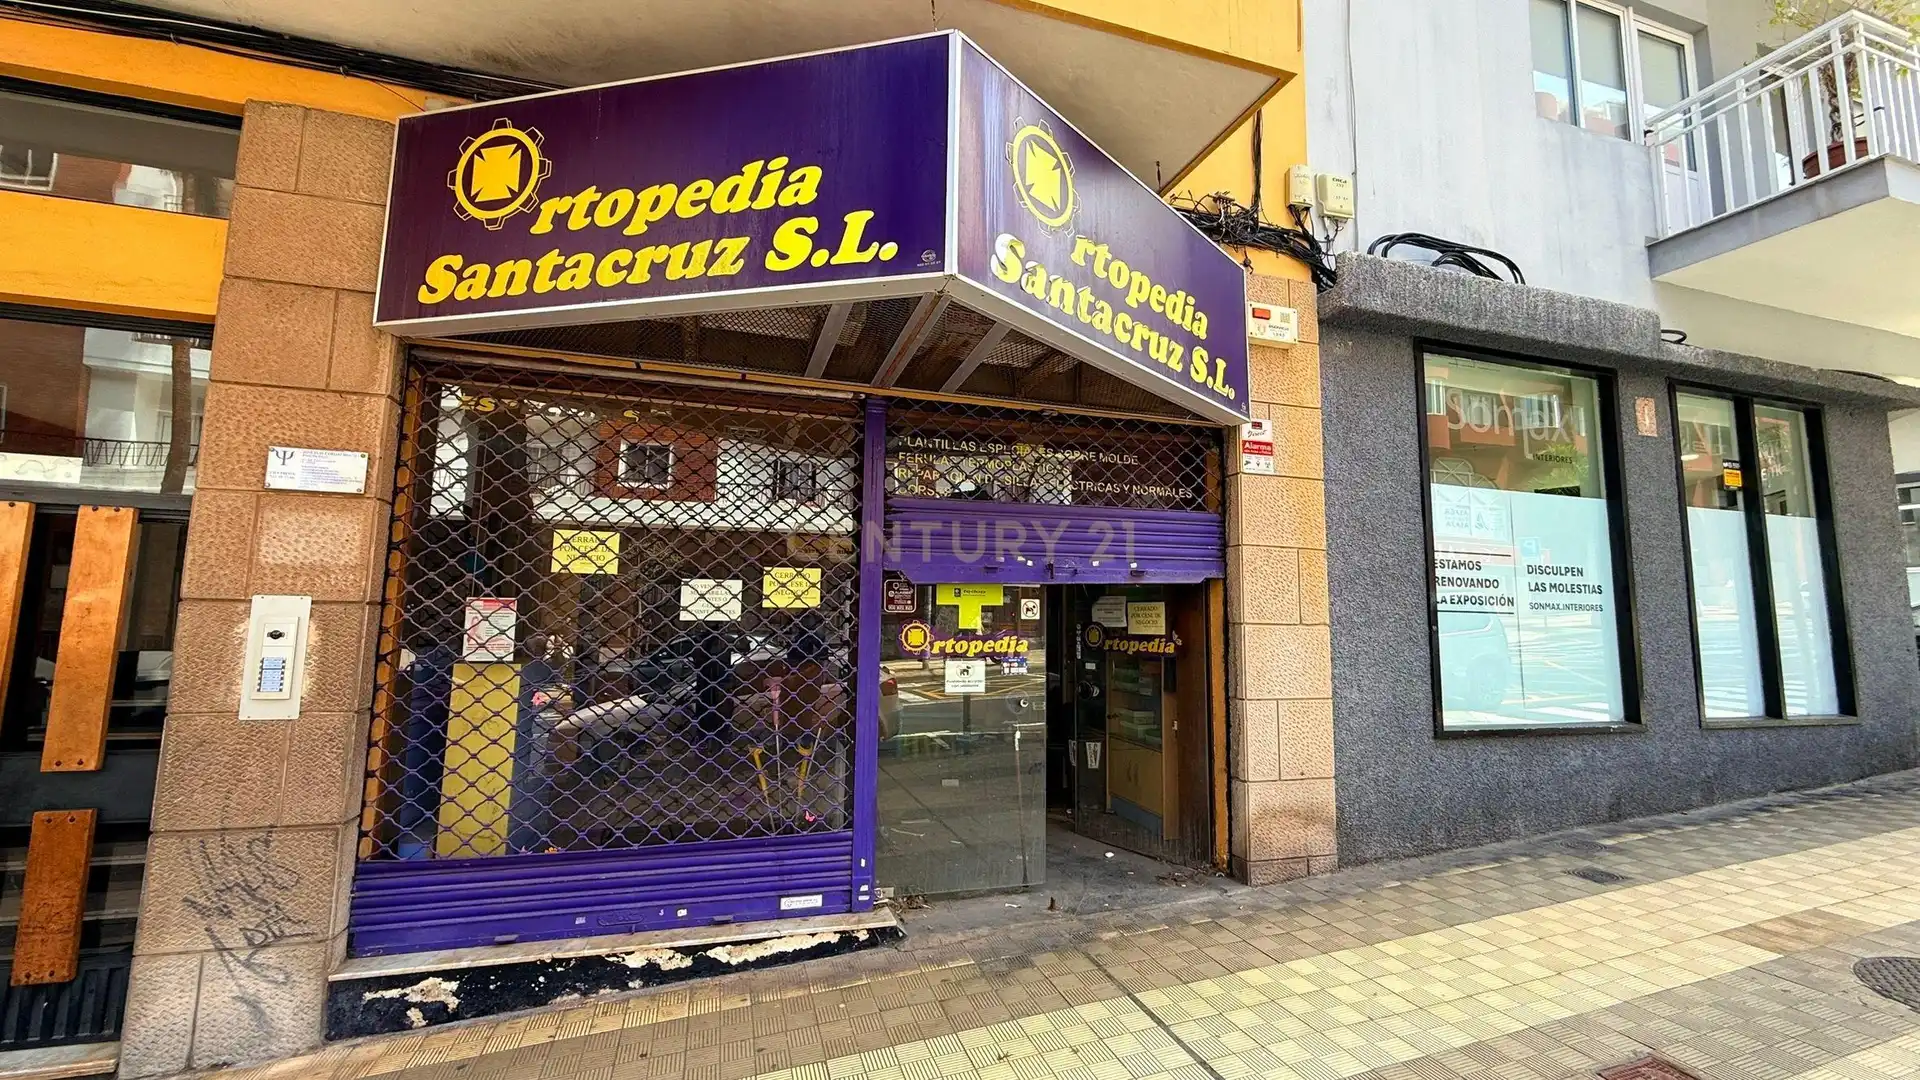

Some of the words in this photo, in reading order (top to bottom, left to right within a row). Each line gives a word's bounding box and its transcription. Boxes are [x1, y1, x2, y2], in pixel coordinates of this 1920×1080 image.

[418, 236, 750, 304] Santacruz
[765, 210, 899, 272] S.L.
[990, 233, 1185, 373] Santacruz
[1190, 345, 1236, 400] S.L.
[1099, 452, 1138, 466] MOLDE
[1532, 453, 1573, 465] INTERIORES
[1122, 484, 1130, 495] Y
[1132, 485, 1193, 498] NORMALES
[1434, 559, 1482, 571] ESTAMOS
[1527, 565, 1584, 577] DISCULPEN
[1435, 576, 1500, 589] RENOVANDO
[1528, 582, 1547, 593] LAS
[1550, 582, 1603, 595] MOLESTIAS
[1450, 594, 1515, 606] EXPOSICIÓN
[1529, 602, 1603, 612] SONMAX.INTERIORES
